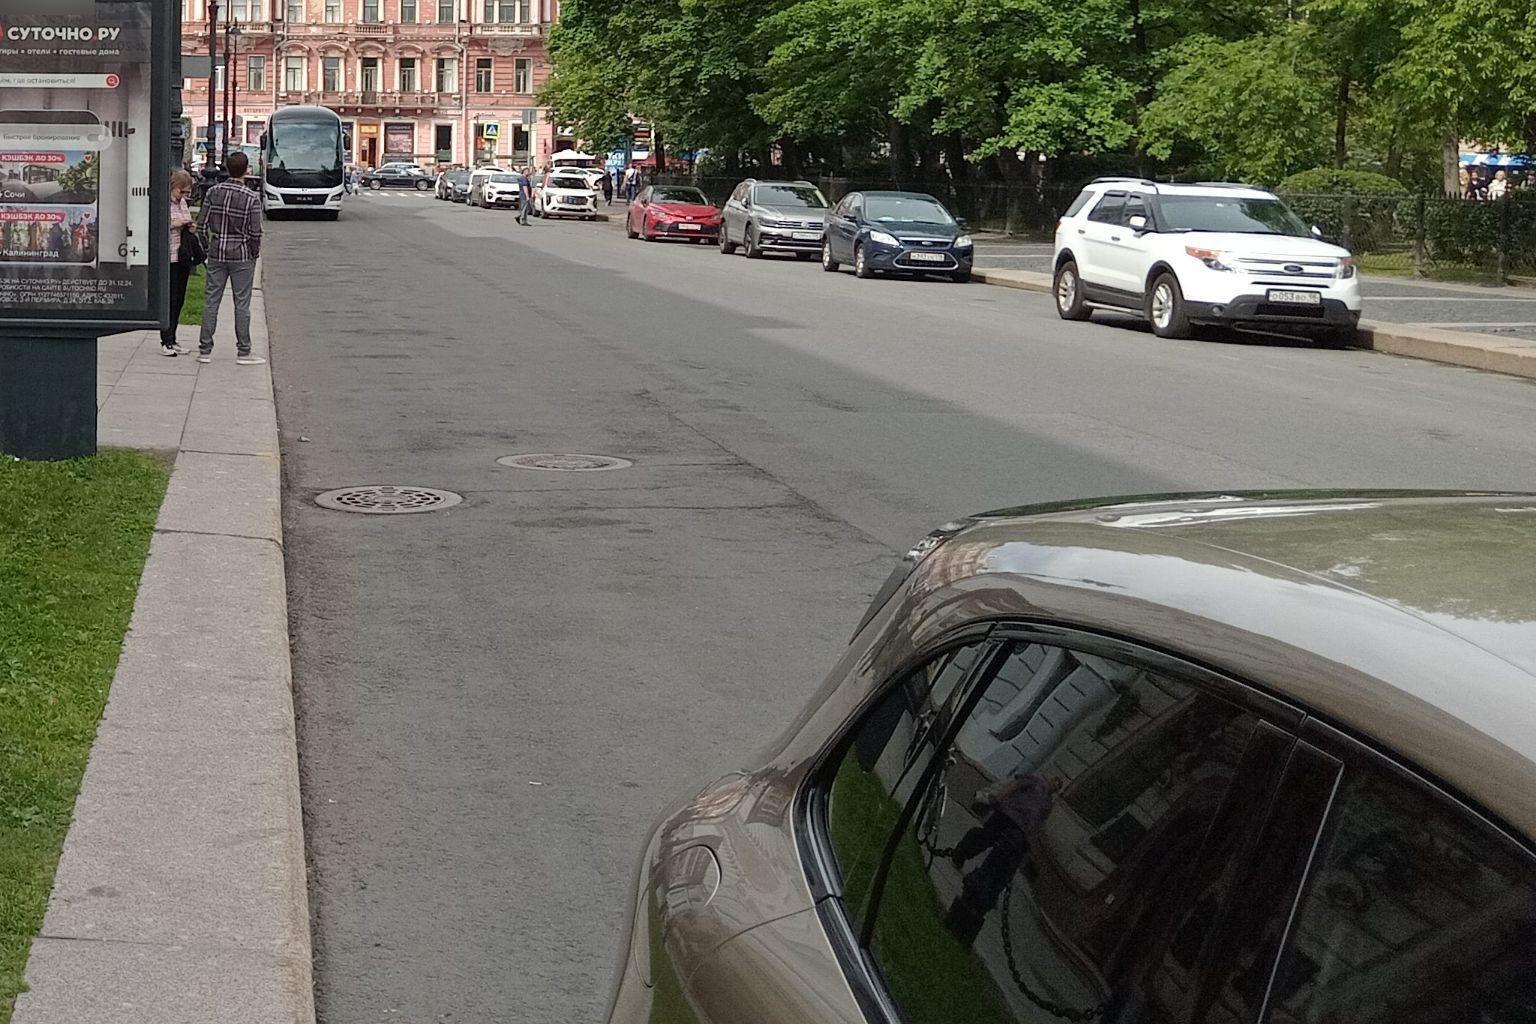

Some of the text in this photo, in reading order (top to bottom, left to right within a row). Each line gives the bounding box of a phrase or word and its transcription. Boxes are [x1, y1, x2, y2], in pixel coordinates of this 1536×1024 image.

[7, 26, 120, 41] СУТОЧНО.РУ
[59, 48, 97, 56] гостевые
[98, 48, 120, 57] дома
[32, 132, 81, 142] бронирование
[1, 154, 63, 163] КЭШБЭК ДО 30%
[3, 190, 26, 198] Сочи
[0, 212, 62, 221] КЭШБЭК ДО 30%
[2, 249, 59, 258] Калининград
[117, 243, 140, 258] 6+
